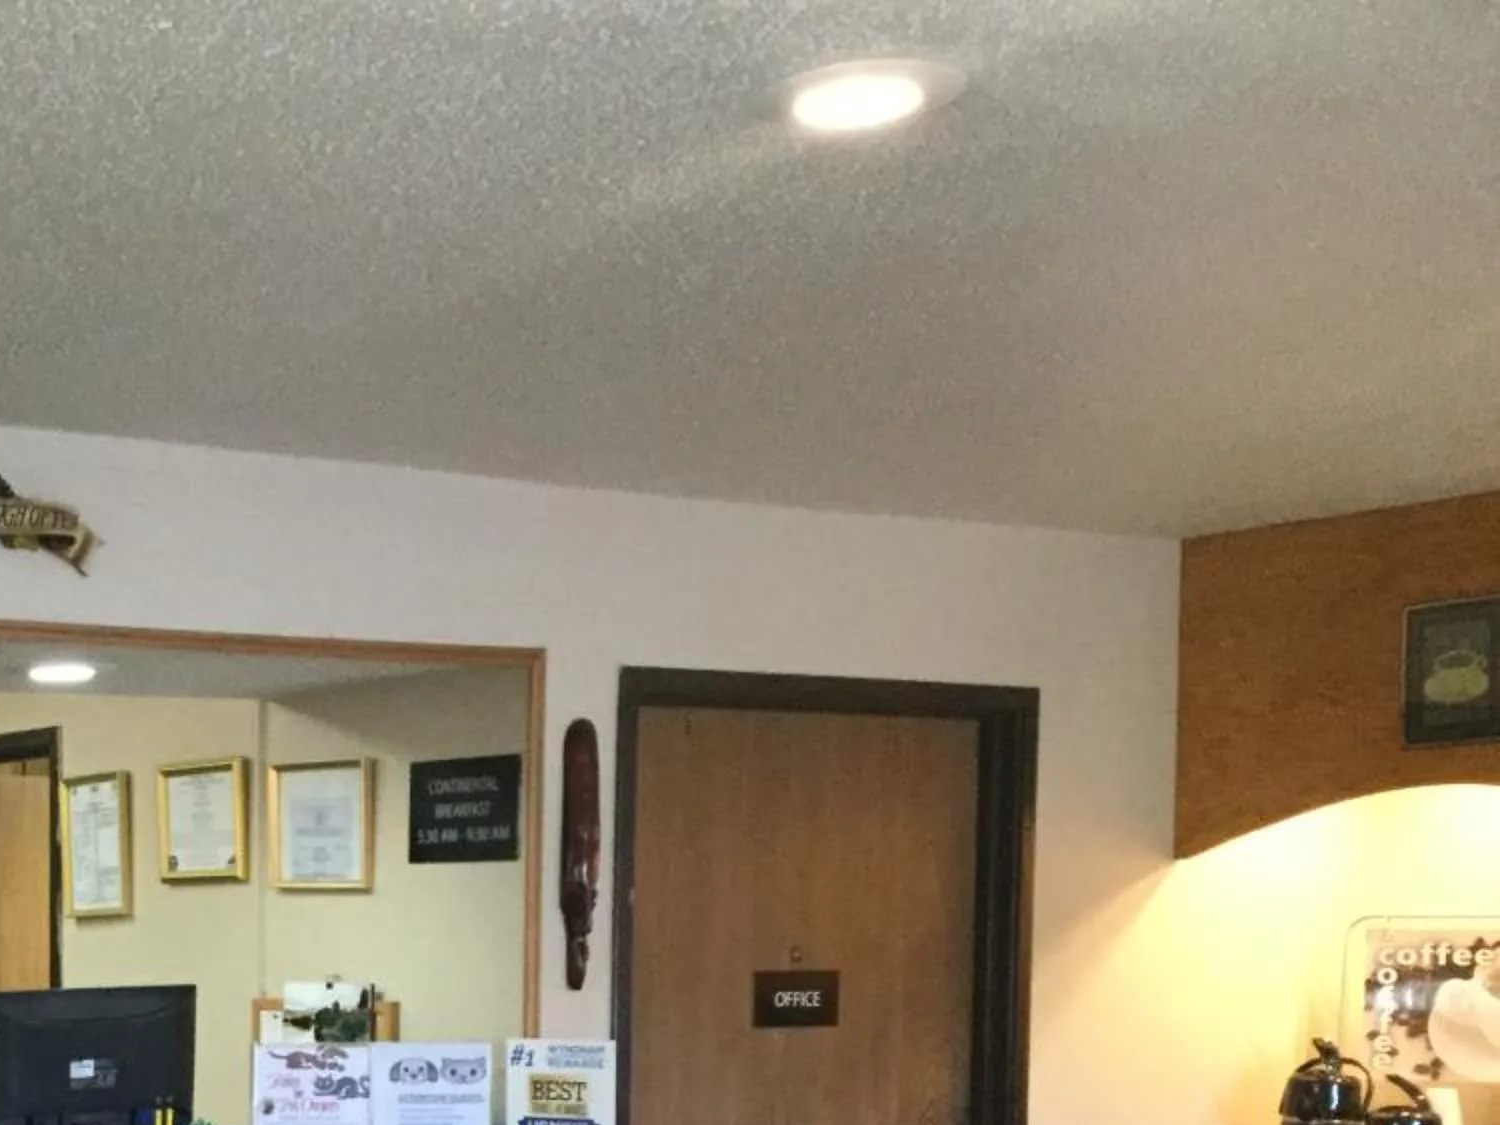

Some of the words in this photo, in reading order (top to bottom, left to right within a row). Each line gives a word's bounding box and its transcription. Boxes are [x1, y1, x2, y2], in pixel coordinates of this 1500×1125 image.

[1378, 942, 1495, 967] coffee
[775, 991, 821, 1007] OFFICE
[510, 1044, 535, 1067] #1
[531, 1080, 588, 1102] BEST
